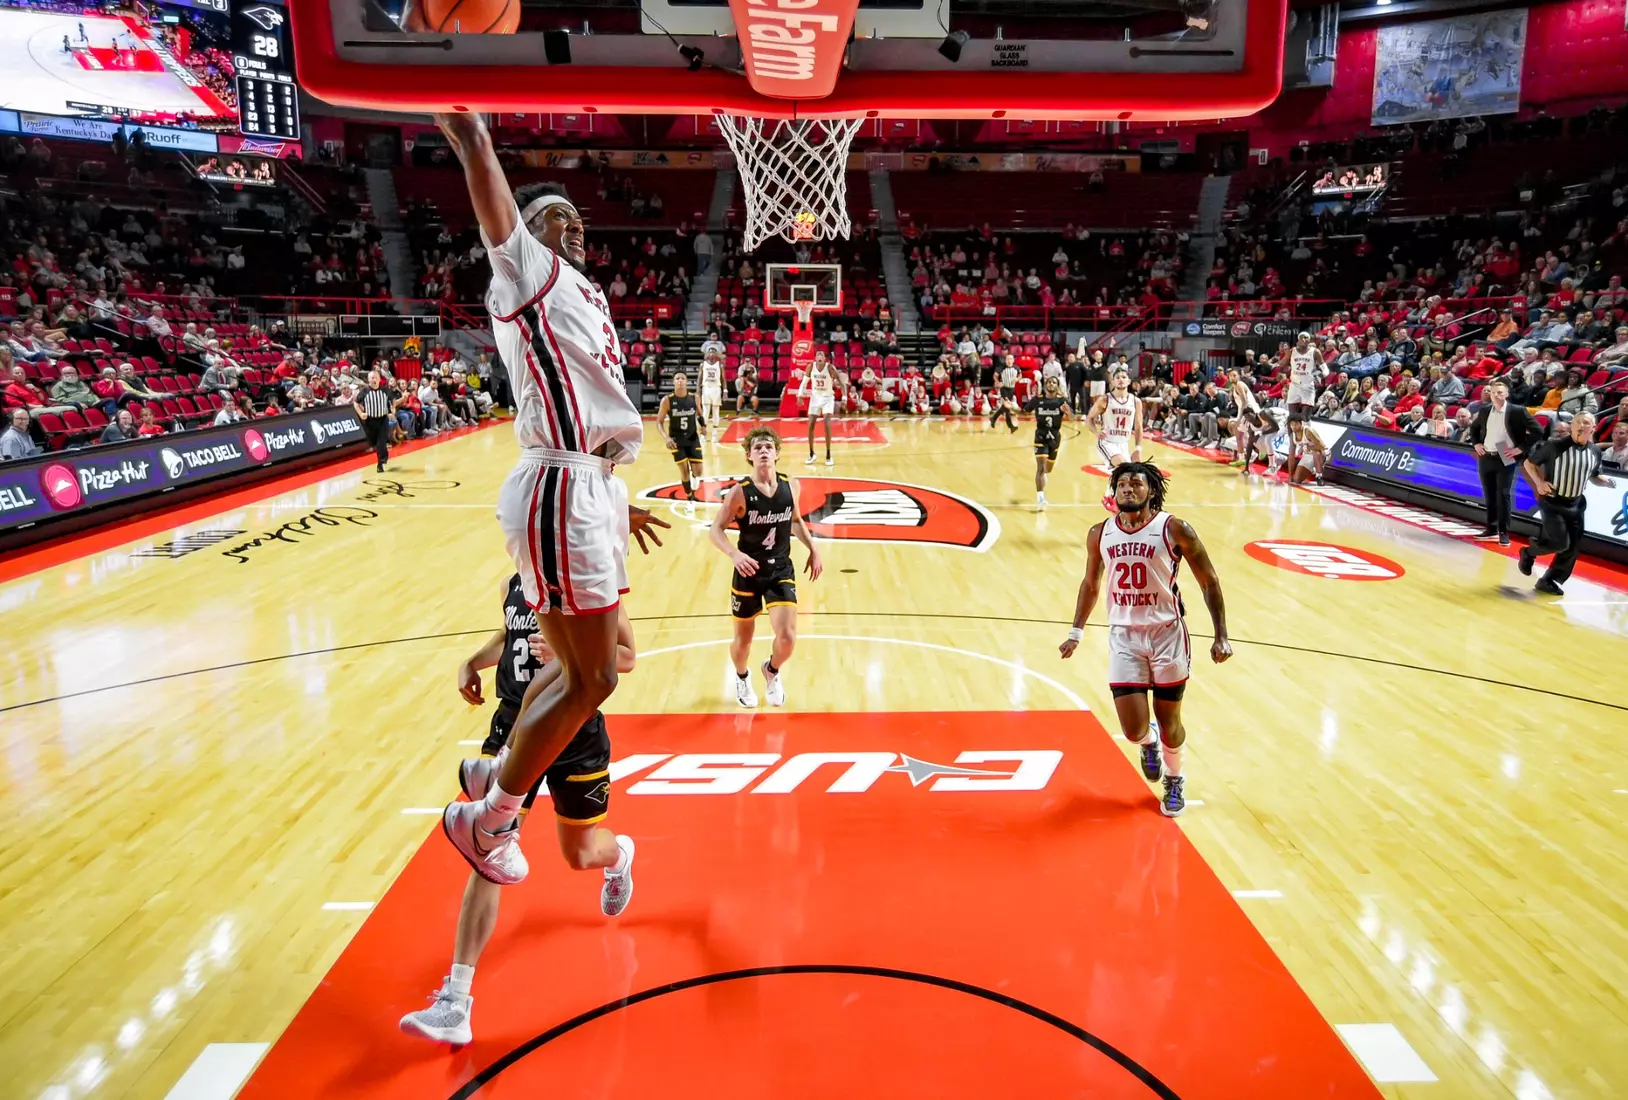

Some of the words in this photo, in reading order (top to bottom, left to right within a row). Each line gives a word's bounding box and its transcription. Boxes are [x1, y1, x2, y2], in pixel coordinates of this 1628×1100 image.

[253, 35, 279, 58] 28
[994, 44, 1027, 52] GUARDIAN
[247, 80, 254, 90] 3
[266, 84, 273, 93] 2
[285, 86, 291, 95] 2
[248, 91, 255, 100] 4
[267, 94, 274, 103] 2
[102, 106, 114, 114] 28
[248, 101, 256, 111] 5
[287, 107, 292, 116] 1
[73, 119, 87, 128] We
[89, 120, 104, 130] Are
[248, 122, 259, 132] 24
[289, 127, 293, 136] 1
[55, 126, 98, 140] Kentucky's
[147, 131, 181, 145] Ruoff
[242, 142, 282, 154] Budweiser
[1202, 322, 1226, 330] Comfort
[1296, 363, 1307, 372] 24
[324, 422, 344, 437] TACO
[342, 418, 361, 435] BELL
[680, 416, 689, 430] 5
[1045, 416, 1053, 428] 3
[1115, 416, 1127, 429] 14
[264, 430, 290, 453] Pizza
[288, 428, 305, 446] Hut
[182, 448, 215, 468] TACO
[214, 443, 242, 462] BELL
[1341, 439, 1399, 472] Community
[79, 466, 123, 495] Pizza
[121, 461, 150, 484] Hut
[748, 506, 793, 526] Montevallo
[761, 527, 777, 550] 4
[1106, 541, 1156, 560] WESTERN
[1115, 561, 1148, 590] 20
[505, 605, 541, 631] Monte
